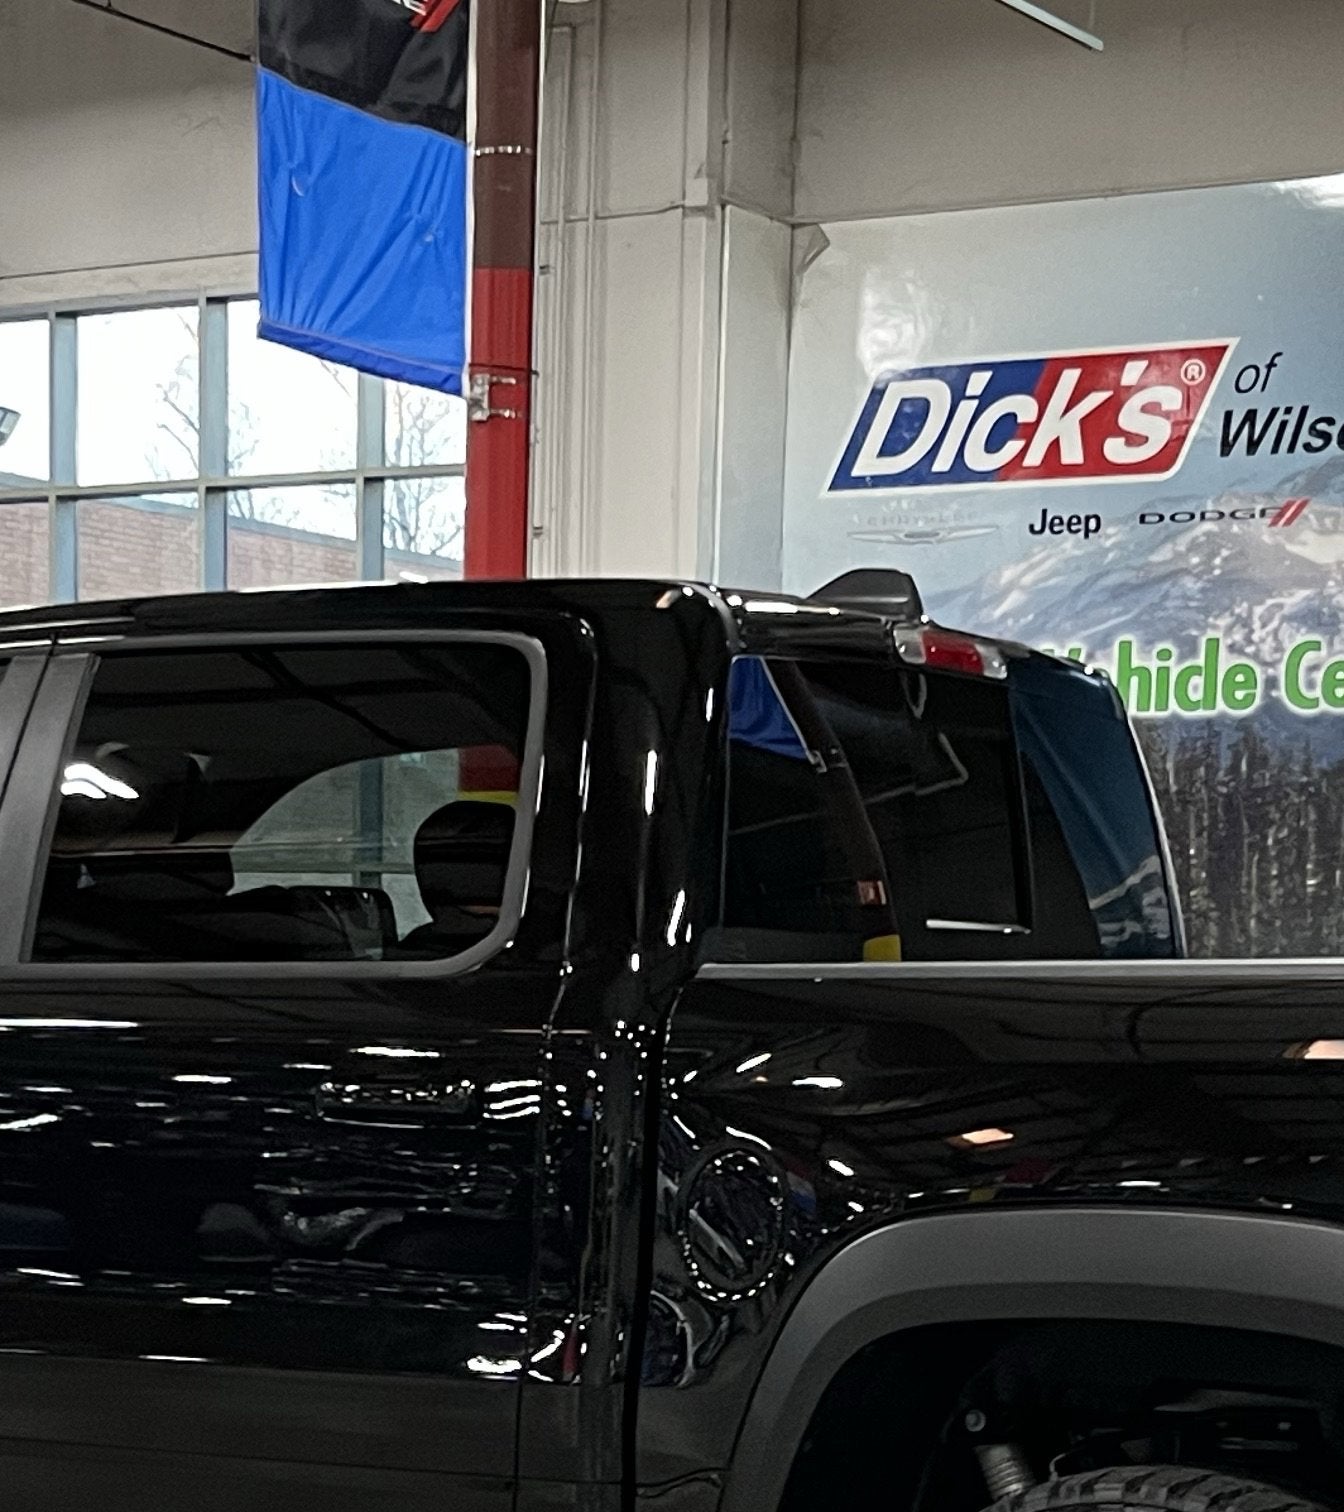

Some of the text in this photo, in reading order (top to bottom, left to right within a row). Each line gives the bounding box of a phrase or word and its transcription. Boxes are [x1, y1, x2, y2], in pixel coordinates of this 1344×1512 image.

[1234, 351, 1284, 394] of
[851, 359, 1184, 478] Dick's
[1028, 508, 1102, 539] Jeep
